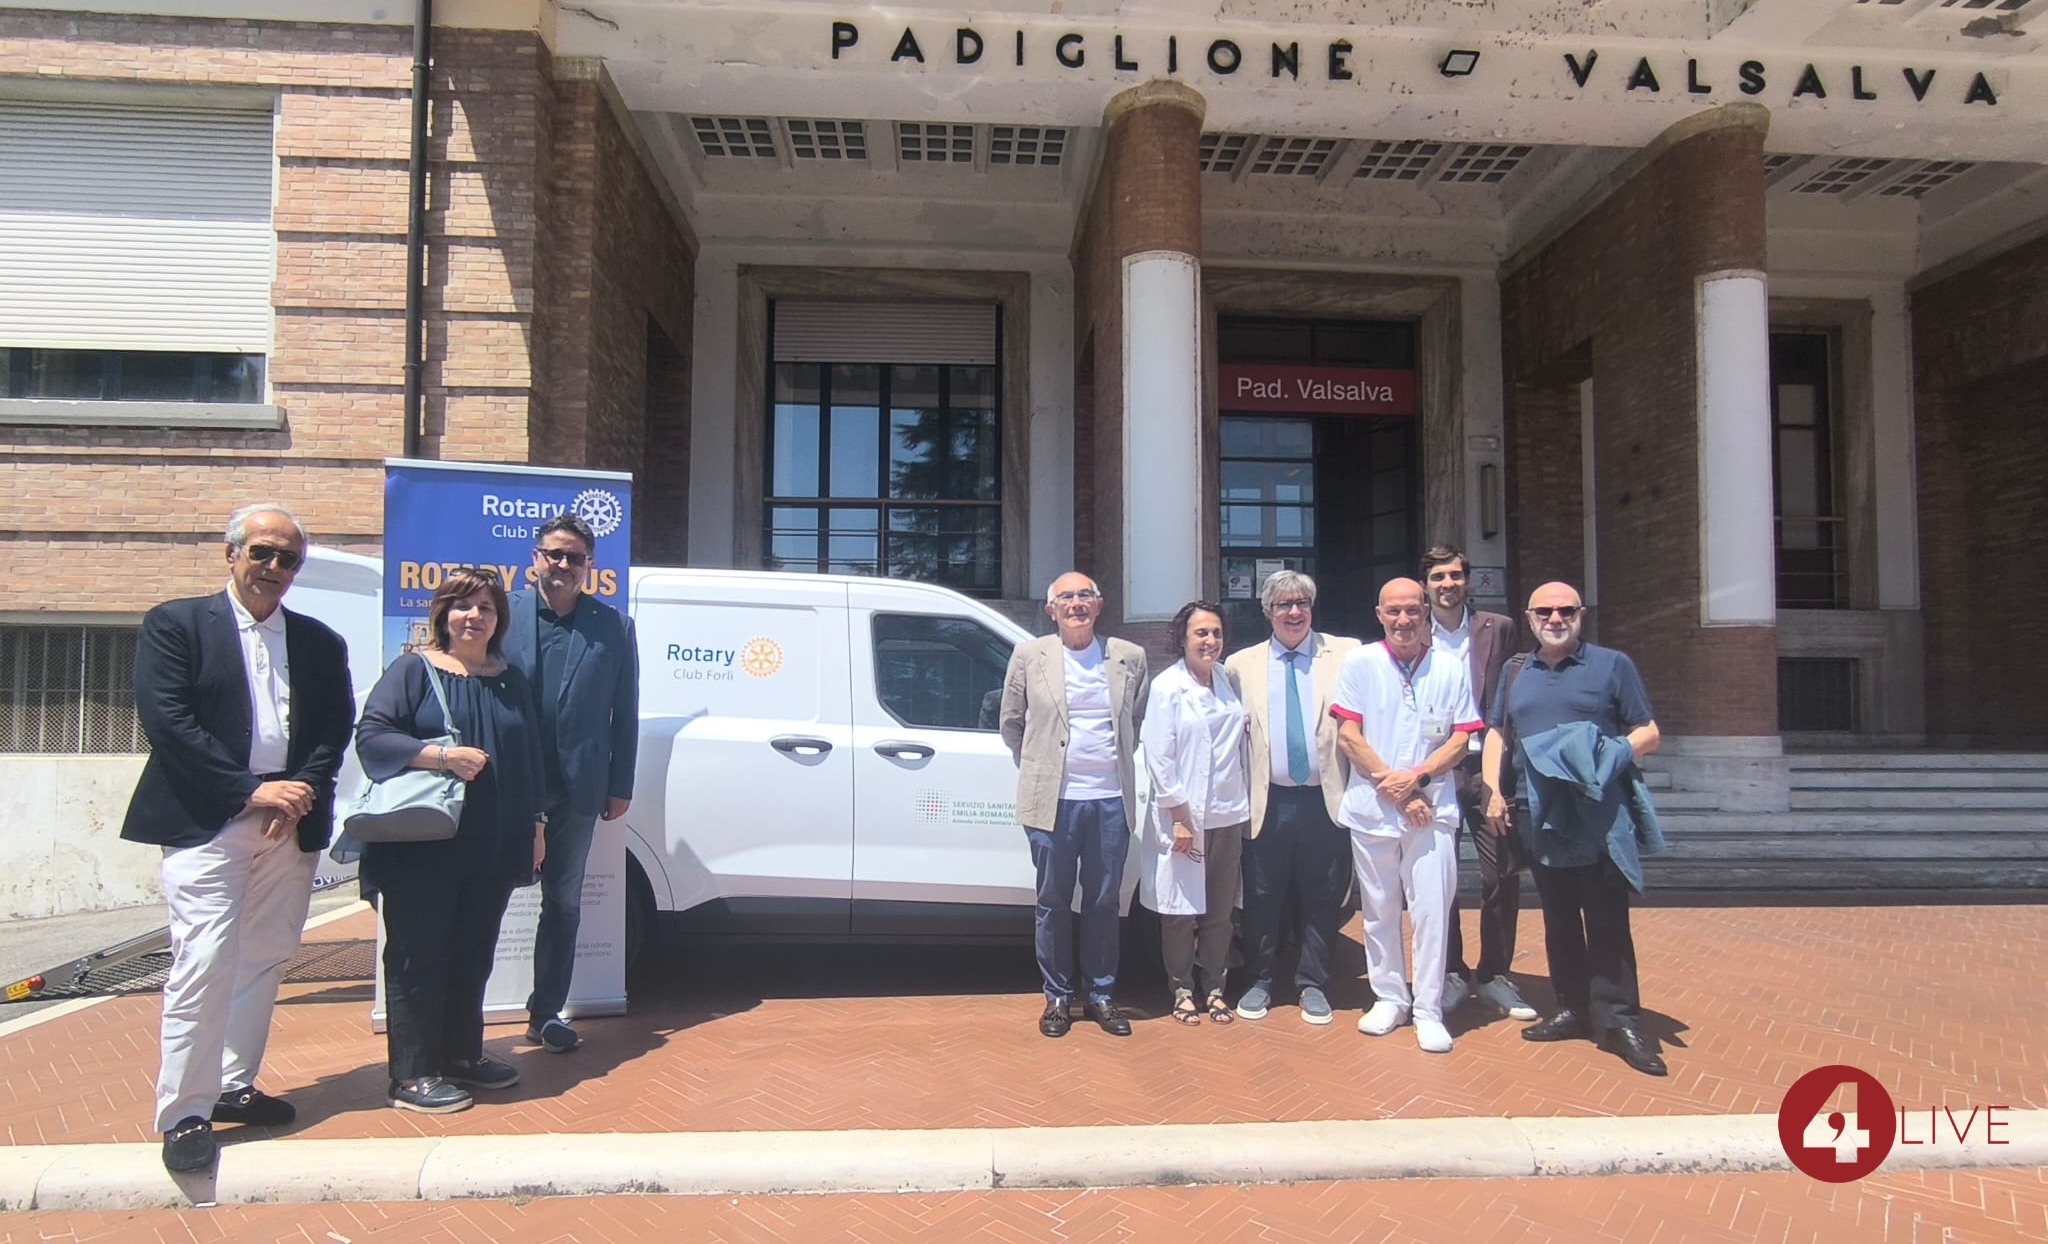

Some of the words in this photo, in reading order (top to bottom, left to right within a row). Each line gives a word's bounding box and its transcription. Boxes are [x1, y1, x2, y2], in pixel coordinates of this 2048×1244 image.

[832, 21, 1352, 80] PADIGLIONE
[1564, 48, 1998, 105] VALSALVA
[1236, 377, 1289, 399] Pad.
[1297, 378, 1394, 402] Valsalva
[482, 494, 565, 519] Rotary
[492, 524, 527, 538] Club
[524, 566, 617, 596] SUS
[400, 597, 414, 607] La
[667, 643, 735, 667] Rotary
[673, 668, 703, 680] Club
[952, 801, 985, 809] SERVIZIO
[979, 811, 1016, 819] ROMAGN
